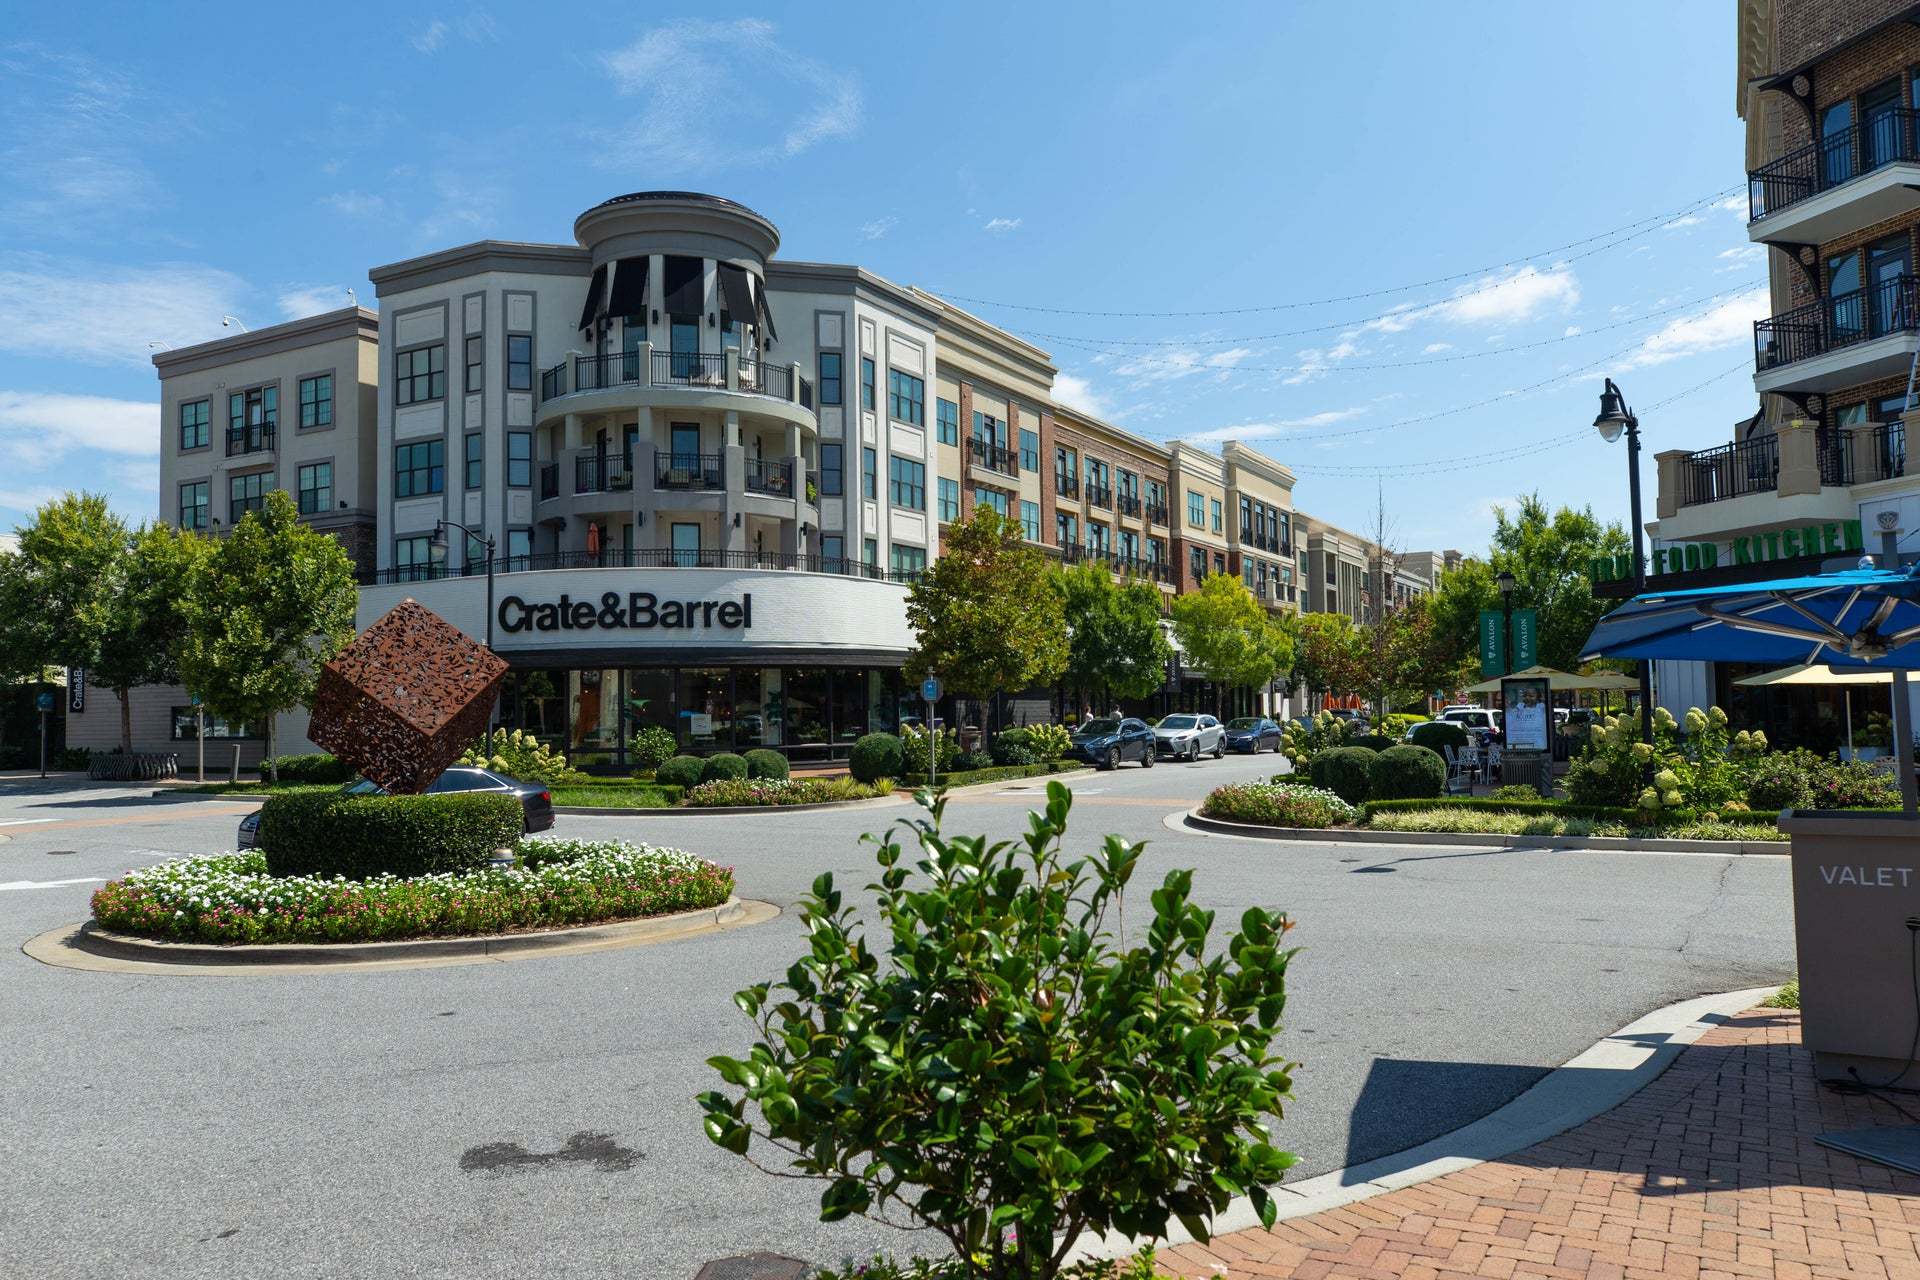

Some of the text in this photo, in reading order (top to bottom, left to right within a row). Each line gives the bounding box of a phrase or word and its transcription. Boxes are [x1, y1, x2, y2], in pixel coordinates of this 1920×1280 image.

[1652, 542, 1718, 576] FOOD
[1733, 519, 1864, 565] KITCHEN
[498, 591, 752, 633] Crate&Barrel
[1488, 618, 1496, 651] AVALON
[1520, 618, 1528, 651] AVALON
[72, 668, 83, 710] Crate&B
[1819, 865, 1913, 888] VALET
